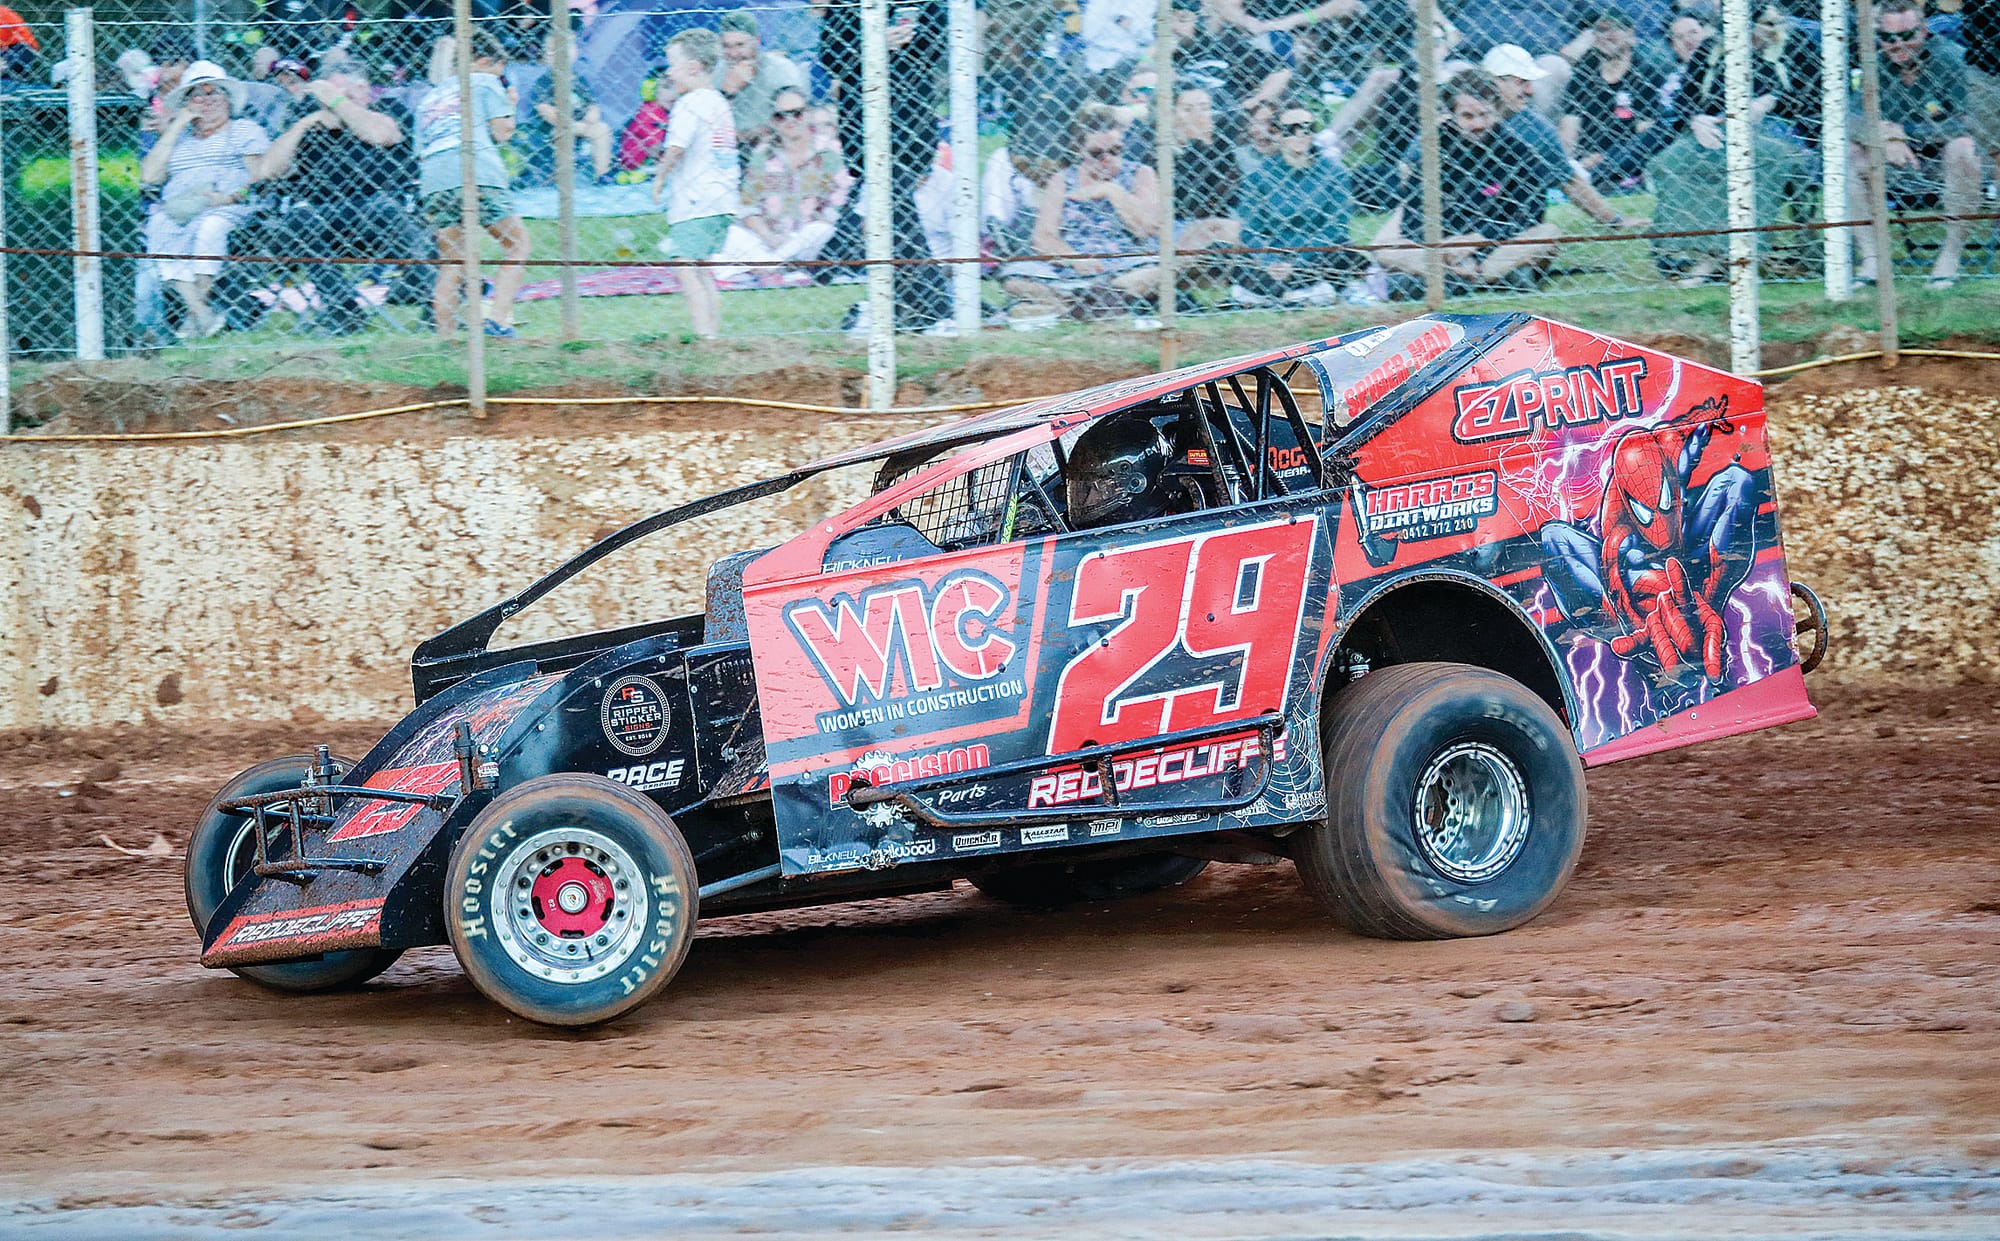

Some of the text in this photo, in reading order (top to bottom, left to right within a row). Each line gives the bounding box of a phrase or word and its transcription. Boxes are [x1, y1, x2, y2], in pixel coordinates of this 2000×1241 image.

[1457, 361, 1645, 440] EZPRINT
[1367, 474, 1496, 517] HARRIS
[1370, 497, 1494, 531] DIRTWORKS
[1402, 517, 1474, 540] 0412 772 210
[789, 576, 1017, 706] WIC
[1046, 514, 1319, 757] 29
[610, 712, 662, 727] STICKER
[613, 704, 657, 719] RIPPER
[819, 679, 1024, 734] WOMEN IN CONSTRUCTION
[607, 759, 685, 786] PACE
[937, 783, 988, 807] Parts
[1296, 790, 1324, 801] HOOKER
[1030, 826, 1066, 837] ALLSTAR
[461, 820, 518, 942] Hoosier
[619, 873, 681, 996] Hoosier
